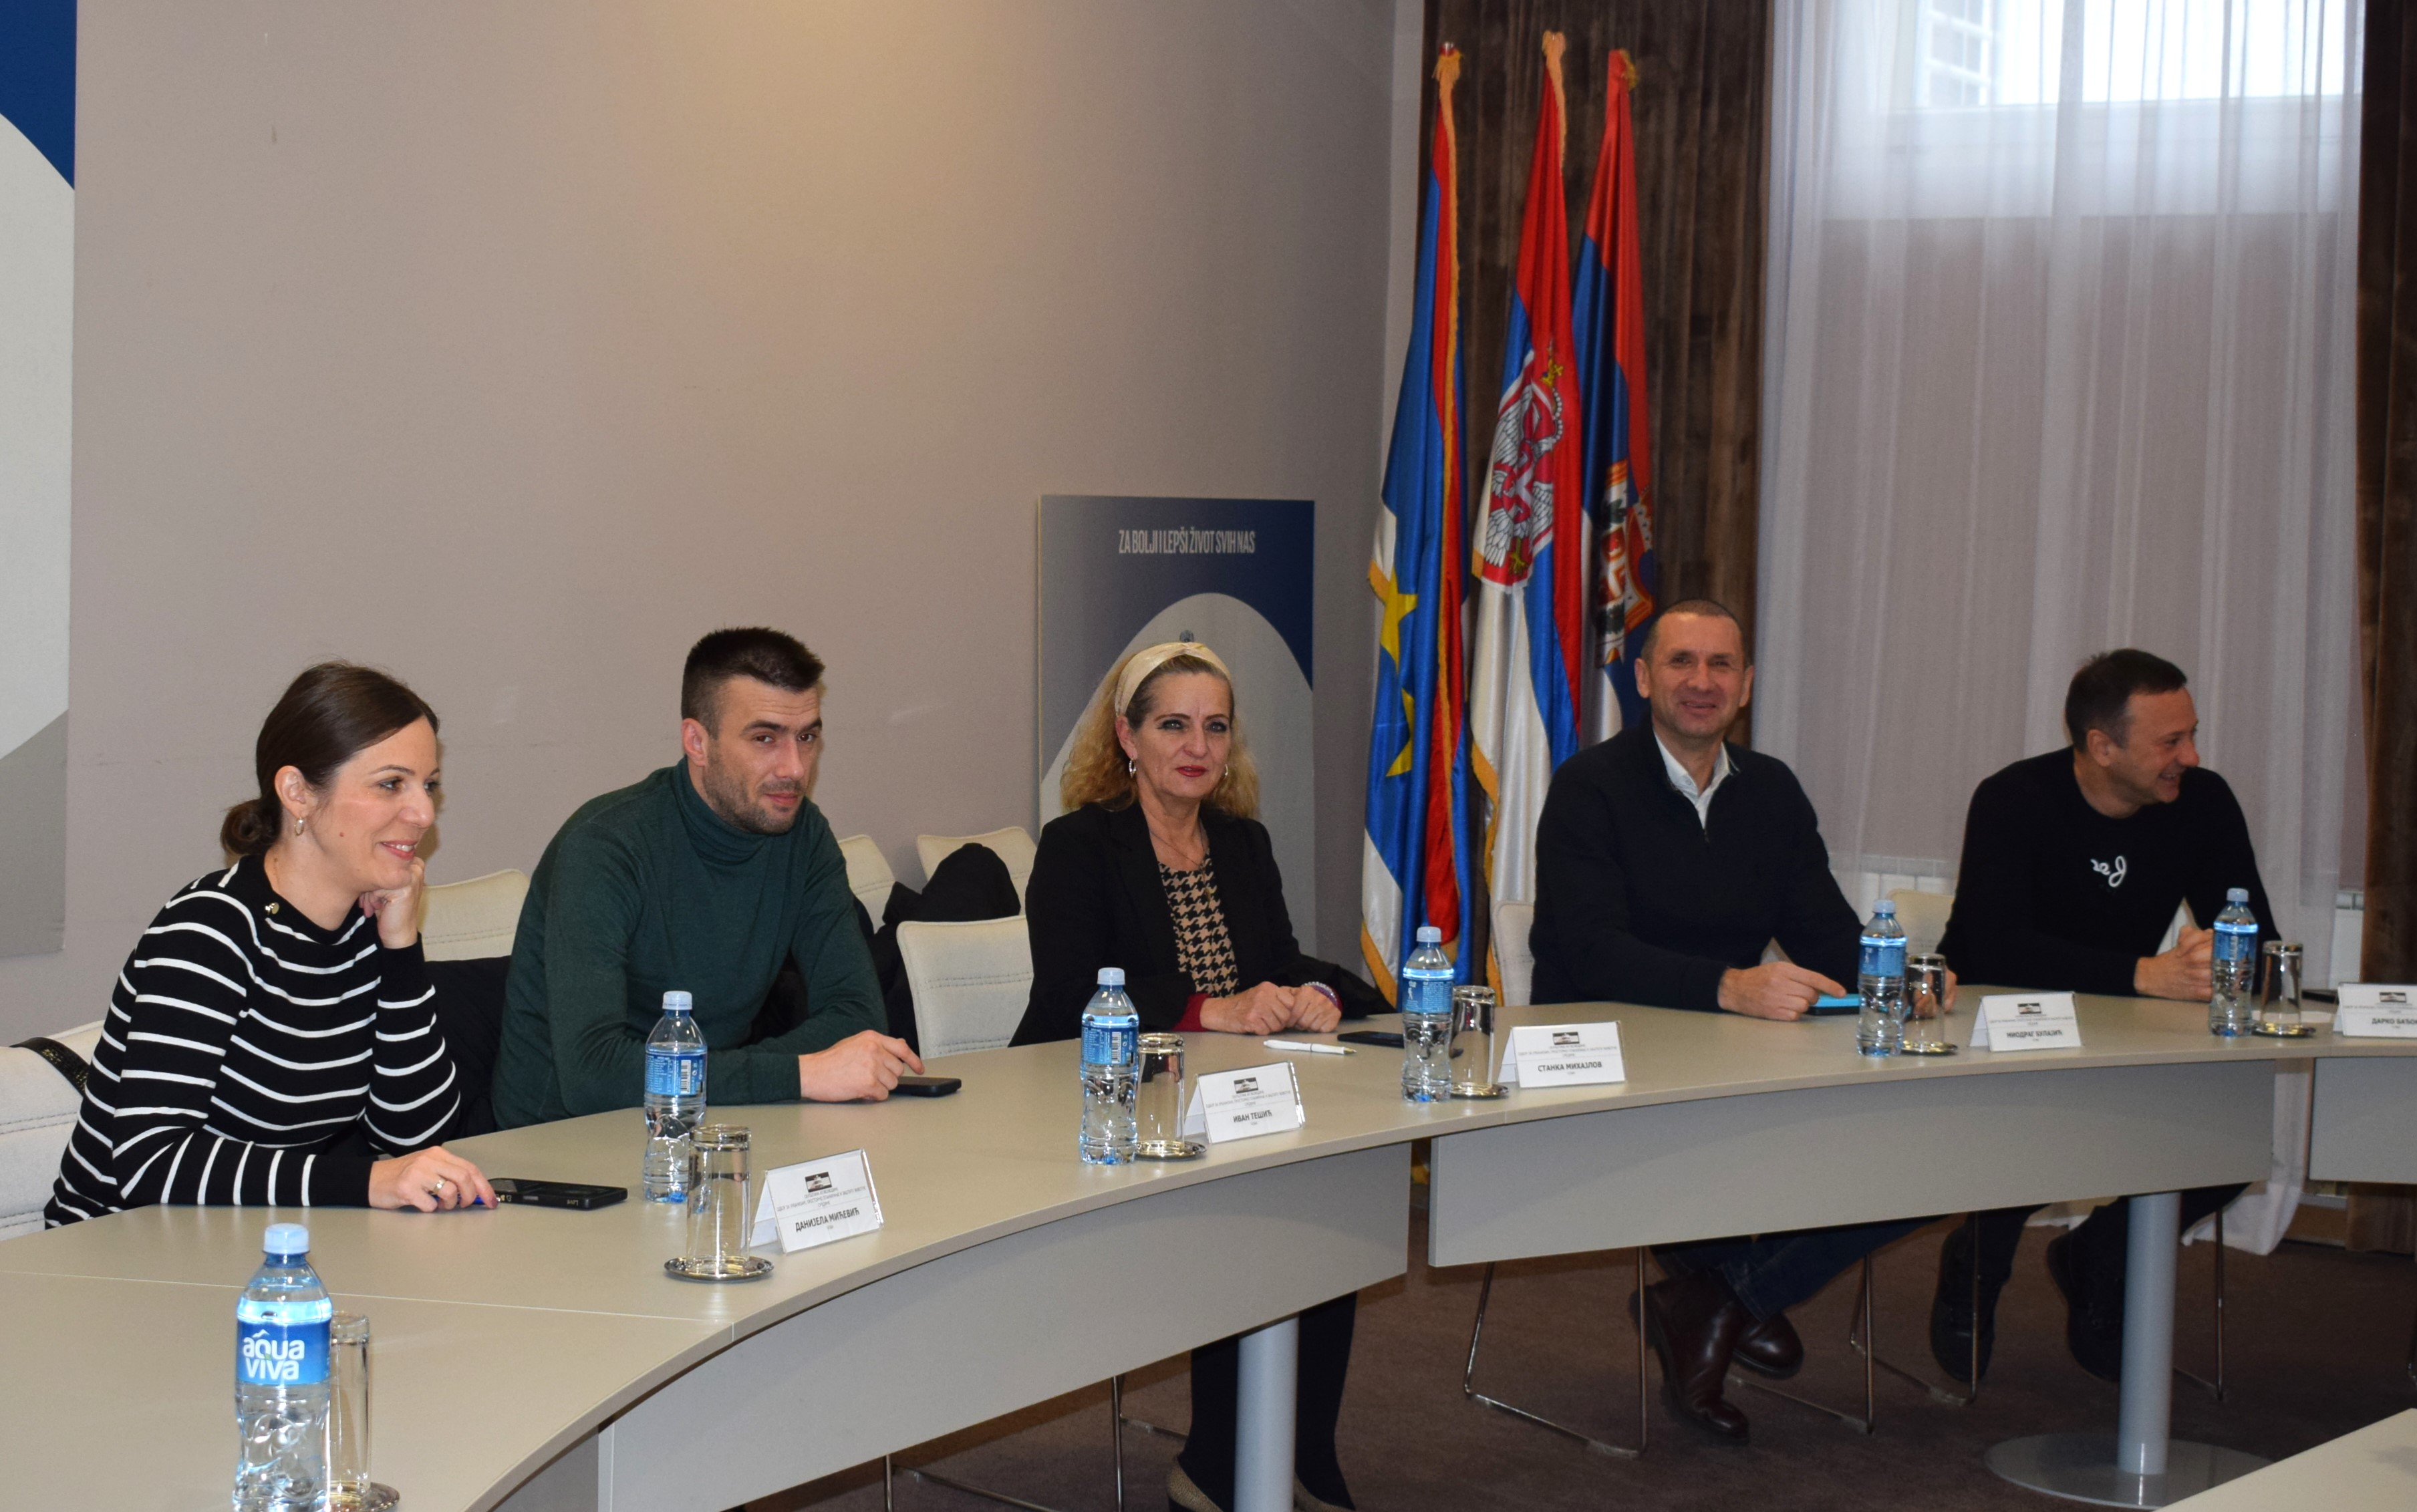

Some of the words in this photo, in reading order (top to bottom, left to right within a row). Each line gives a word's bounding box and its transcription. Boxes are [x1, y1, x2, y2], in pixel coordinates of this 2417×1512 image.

[1119, 529, 1131, 553] ZA
[1132, 529, 1158, 553] BOLJI
[1163, 526, 1188, 553] LEPŠI
[1189, 526, 1215, 553] ŽIVOT
[1216, 530, 1236, 553] SVIH
[1237, 530, 1256, 553] NAS
[1538, 1064, 1564, 1072] СТАНКА
[1566, 1061, 1602, 1069] МИХАЈЛОВ
[1233, 1113, 1250, 1122] ИВАН
[1250, 1110, 1272, 1120] ТЕШИЋ
[795, 1215, 829, 1232] ДАНИЈЕЛА
[829, 1207, 860, 1222] МИЋЕВИЋ
[243, 1336, 305, 1360] aqua
[245, 1356, 299, 1380] viva
